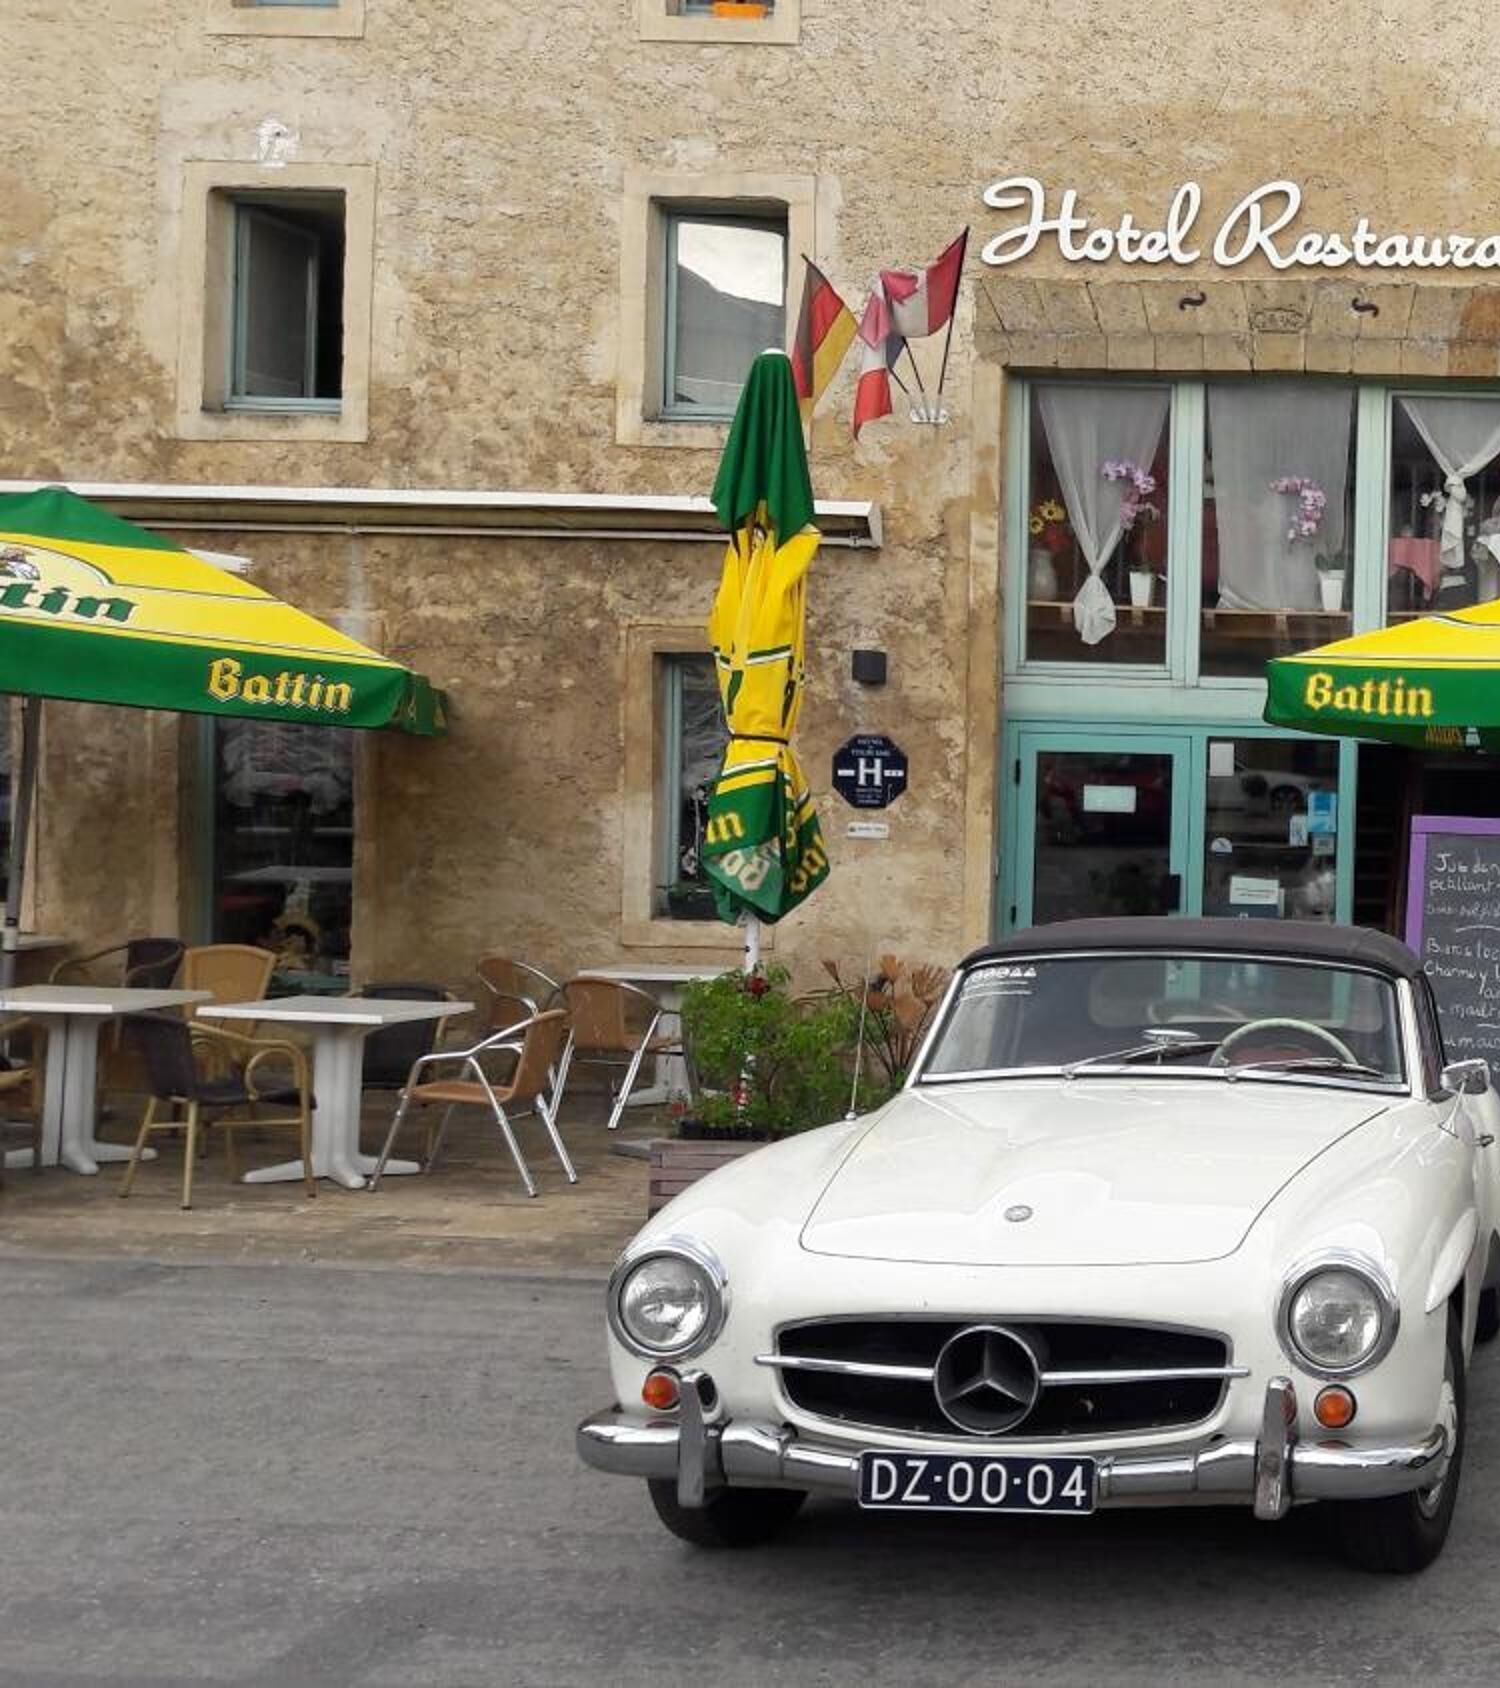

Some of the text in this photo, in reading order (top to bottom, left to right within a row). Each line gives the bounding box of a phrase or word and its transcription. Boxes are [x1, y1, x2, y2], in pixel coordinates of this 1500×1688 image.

[981, 176, 1201, 265] Hotel
[207, 656, 353, 713] Battin
[1305, 671, 1433, 718] Battin
[857, 757, 882, 786] H
